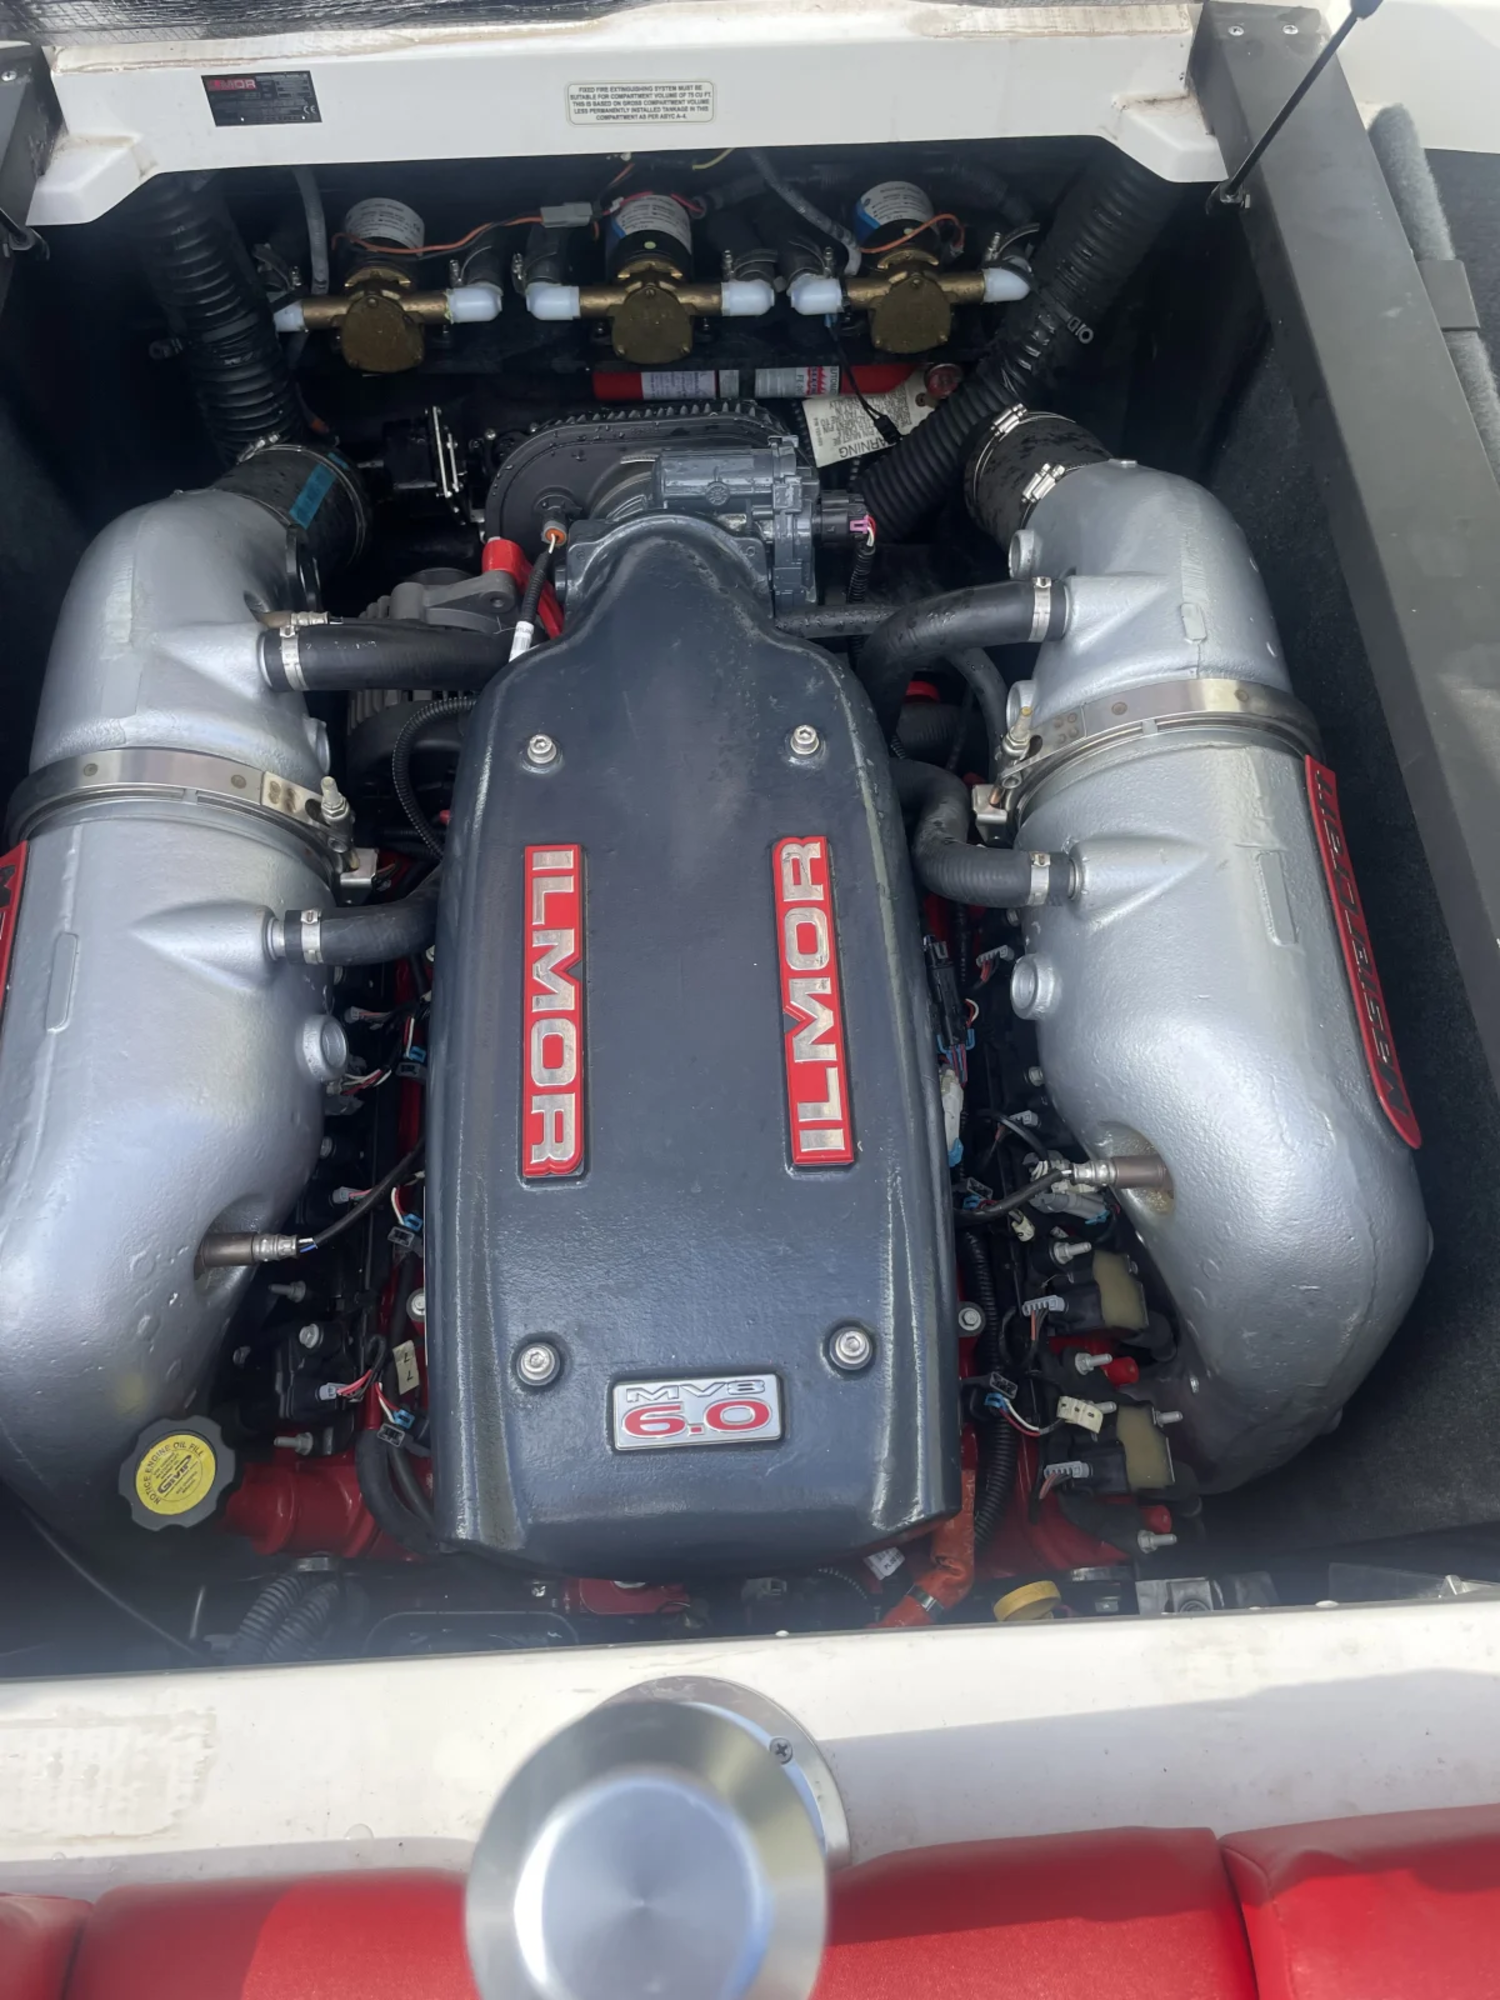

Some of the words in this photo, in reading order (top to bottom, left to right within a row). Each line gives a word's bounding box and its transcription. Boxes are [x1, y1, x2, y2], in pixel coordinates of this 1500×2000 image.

[838, 435, 888, 458] ARNING
[530, 849, 577, 1164] ILMOR
[781, 842, 846, 1153] ILMOR
[626, 1379, 765, 1402] MV8
[622, 1397, 773, 1439] 6.0
[146, 1444, 171, 1473] ENGINE
[173, 1442, 186, 1450] OIL
[188, 1443, 204, 1457] FILL
[144, 1476, 161, 1505] NOTICE
